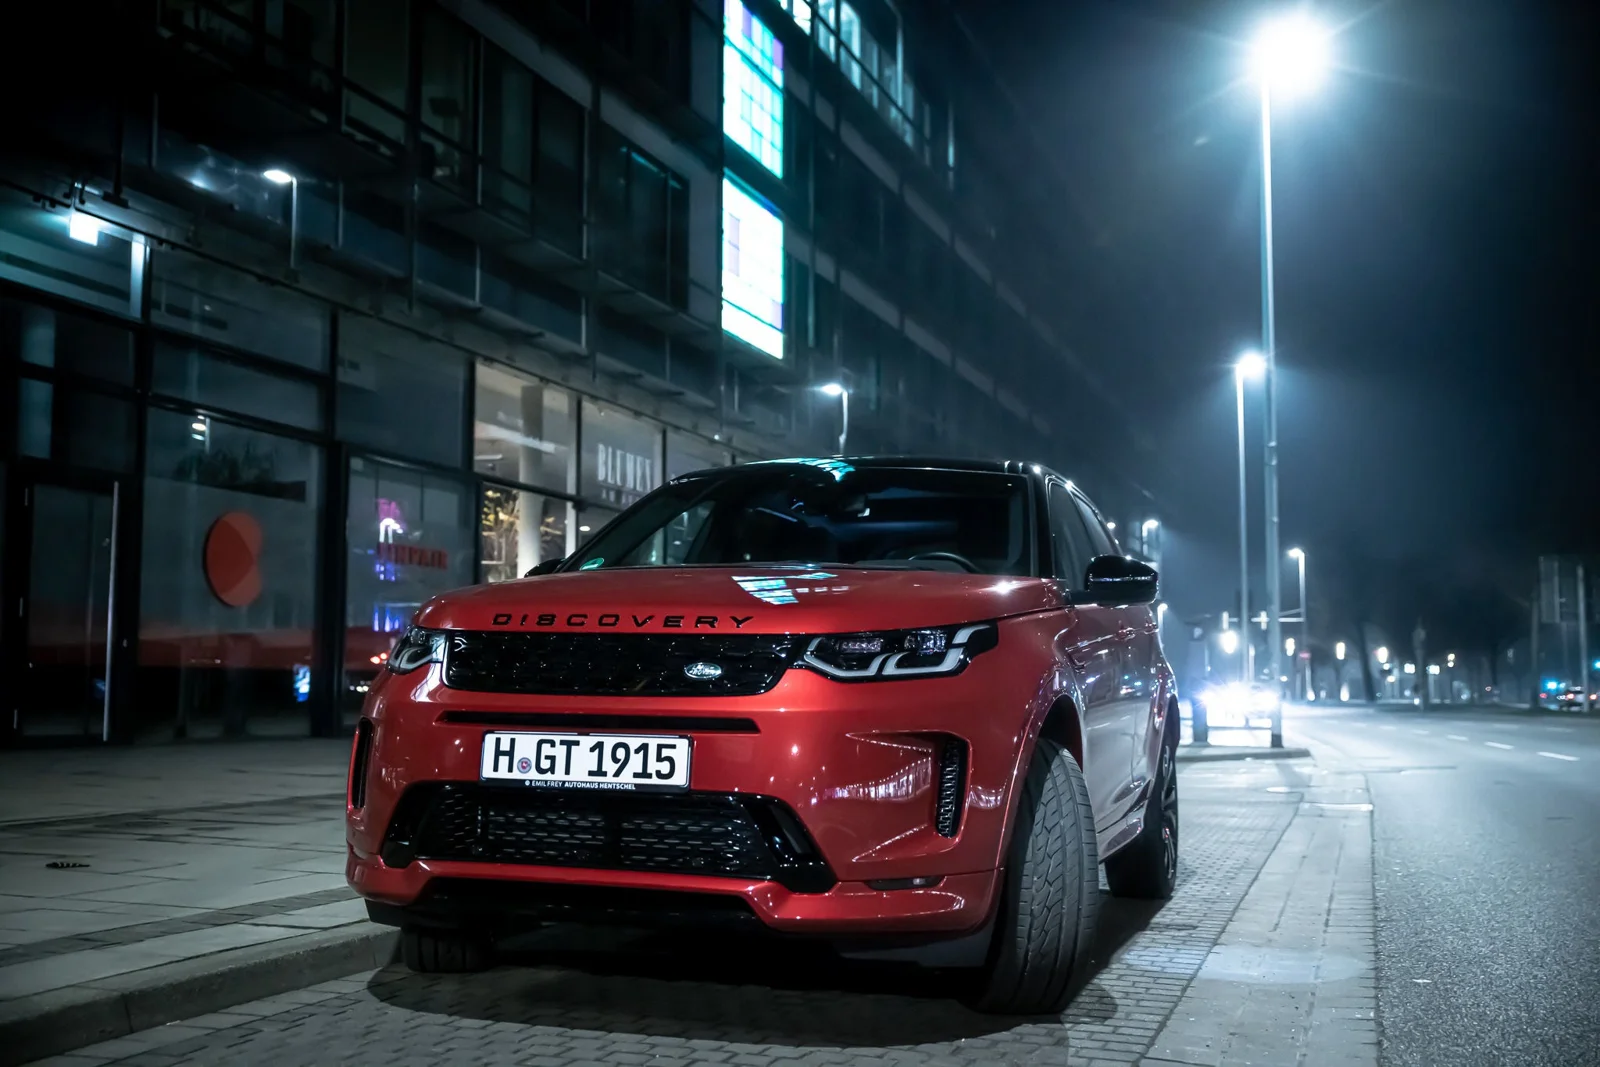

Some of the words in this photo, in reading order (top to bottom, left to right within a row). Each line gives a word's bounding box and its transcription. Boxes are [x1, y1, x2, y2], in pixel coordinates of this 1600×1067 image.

[492, 613, 754, 628] DISCOVERY
[493, 737, 516, 773] H
[535, 738, 580, 776] GT
[588, 741, 677, 780] 1915
[564, 781, 598, 789] AUTOHAUS
